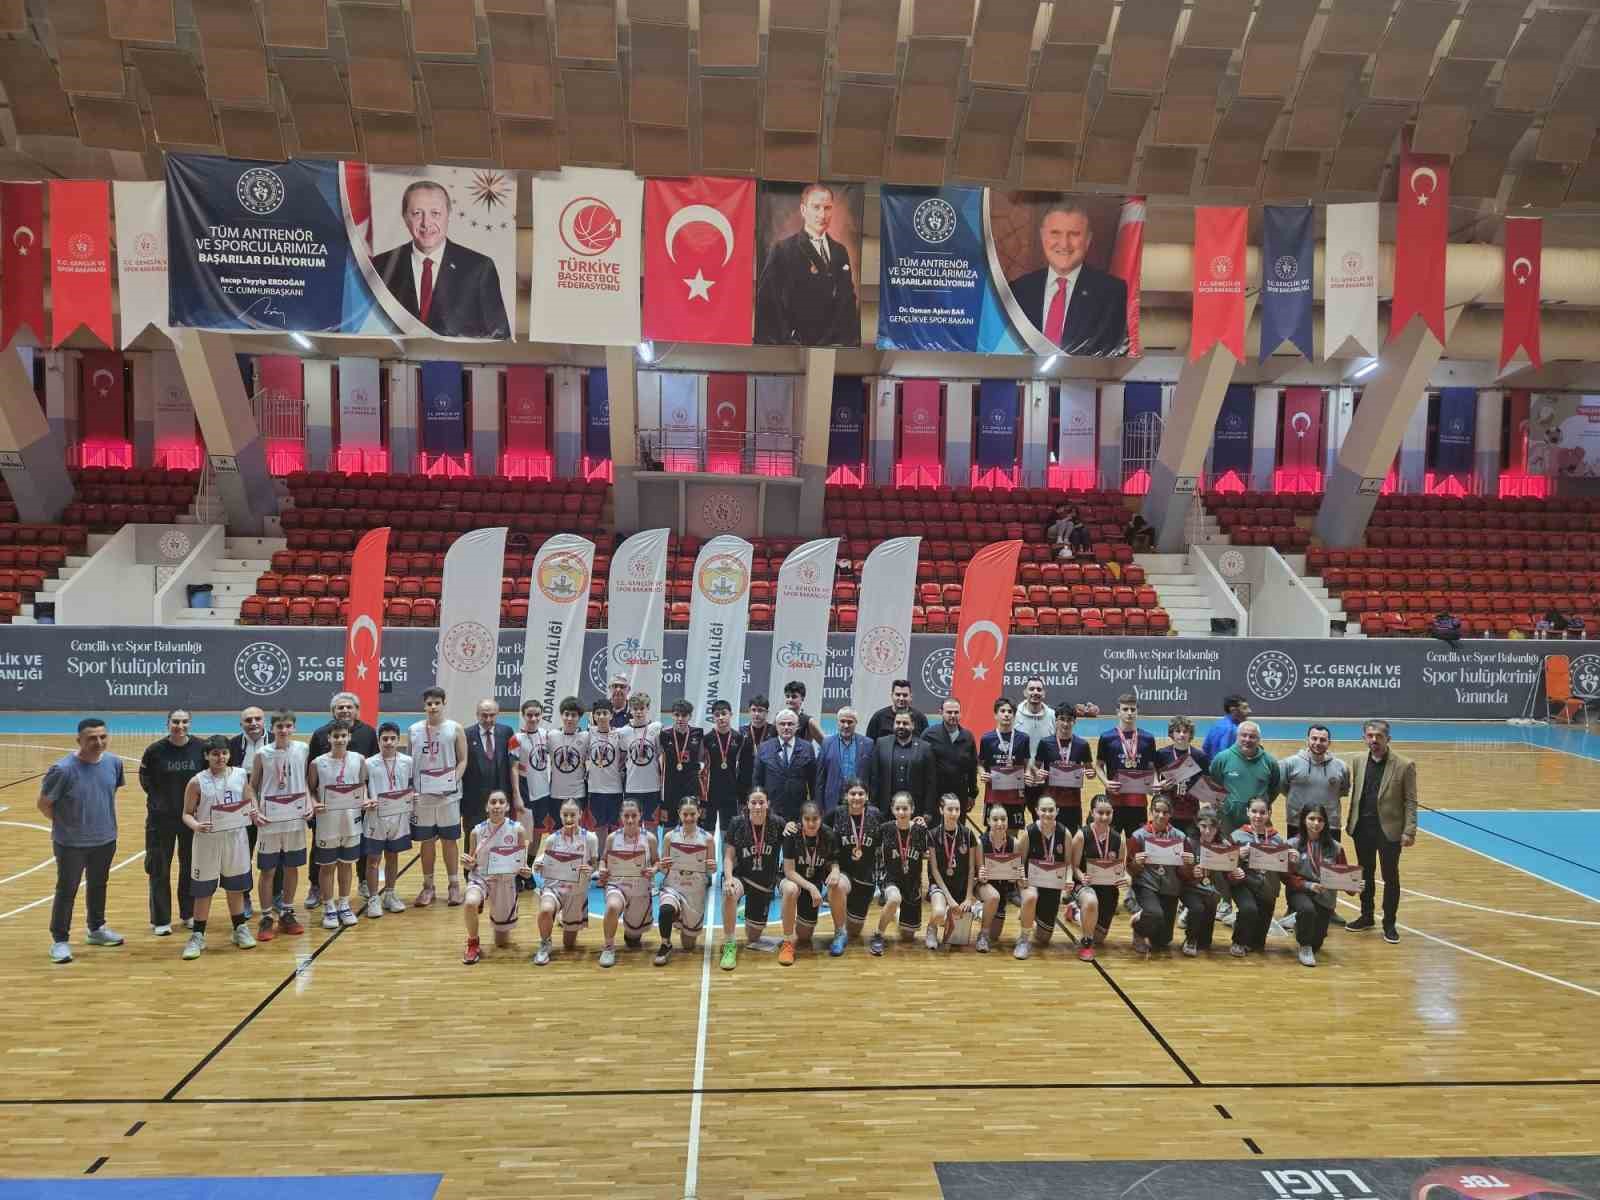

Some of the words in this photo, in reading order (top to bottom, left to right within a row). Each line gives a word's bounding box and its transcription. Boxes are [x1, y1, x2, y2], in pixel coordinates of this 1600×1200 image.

[208, 225, 239, 238] TÜM
[242, 227, 313, 241] ANTRENÖR
[196, 239, 211, 250] VE
[214, 240, 328, 255] SPORCULARIMIZA
[199, 253, 261, 265] BAŞARILAR
[263, 254, 326, 267] DİLİYORUM
[558, 257, 620, 274] TÜRKİYE
[898, 257, 918, 267] TÜM
[920, 258, 968, 269] ANTRENÖR
[558, 272, 620, 283] BASKETBOL
[888, 267, 900, 275] VE
[901, 267, 978, 279] SPORCULARIMIZA
[268, 278, 305, 286] ERDOĞAN
[558, 281, 620, 291] FEDERASYONU
[891, 278, 932, 287] BAŞARILAR
[933, 278, 975, 288] DİLİYORUM
[222, 286, 236, 294] T.C.
[236, 287, 304, 297] CUMHURBAŞKANI
[71, 640, 110, 653] Gençlik
[111, 643, 124, 651] ve
[126, 640, 152, 654] Spor
[154, 640, 202, 655] Bakanlığı
[546, 621, 562, 675] VALİLİĞİ
[708, 622, 724, 676] VALİLİĞİ
[24, 655, 42, 665] VE
[297, 656, 322, 667] T.C.
[390, 657, 407, 668] VE
[1139, 650, 1151, 659] ve
[1151, 648, 1175, 661] Spor
[1177, 648, 1219, 662] Bakanlığı
[1462, 654, 1473, 662] ve
[1473, 651, 1497, 664] Spor
[67, 656, 108, 677] Spor
[111, 657, 206, 677] Kulüplerinin
[1004, 660, 1058, 674] GENÇLİK
[1062, 662, 1079, 672] VE
[1099, 663, 1136, 684] Spor
[1138, 664, 1221, 684] Kulüplerinin
[1303, 664, 1326, 674] T.C.
[1328, 663, 1381, 677] GENÇLİK
[1385, 664, 1401, 675] VE
[297, 671, 332, 682] SPOR
[1303, 678, 1334, 688] SPOR
[1337, 677, 1401, 689] BAKANLIĞI
[1422, 667, 1457, 686] Spor
[106, 680, 168, 696] Yanında
[1132, 684, 1188, 701] Yanında
[543, 680, 556, 723] ADANA
[1455, 688, 1508, 704] Yanında
[1261, 1169, 1372, 1198] LİGİ
